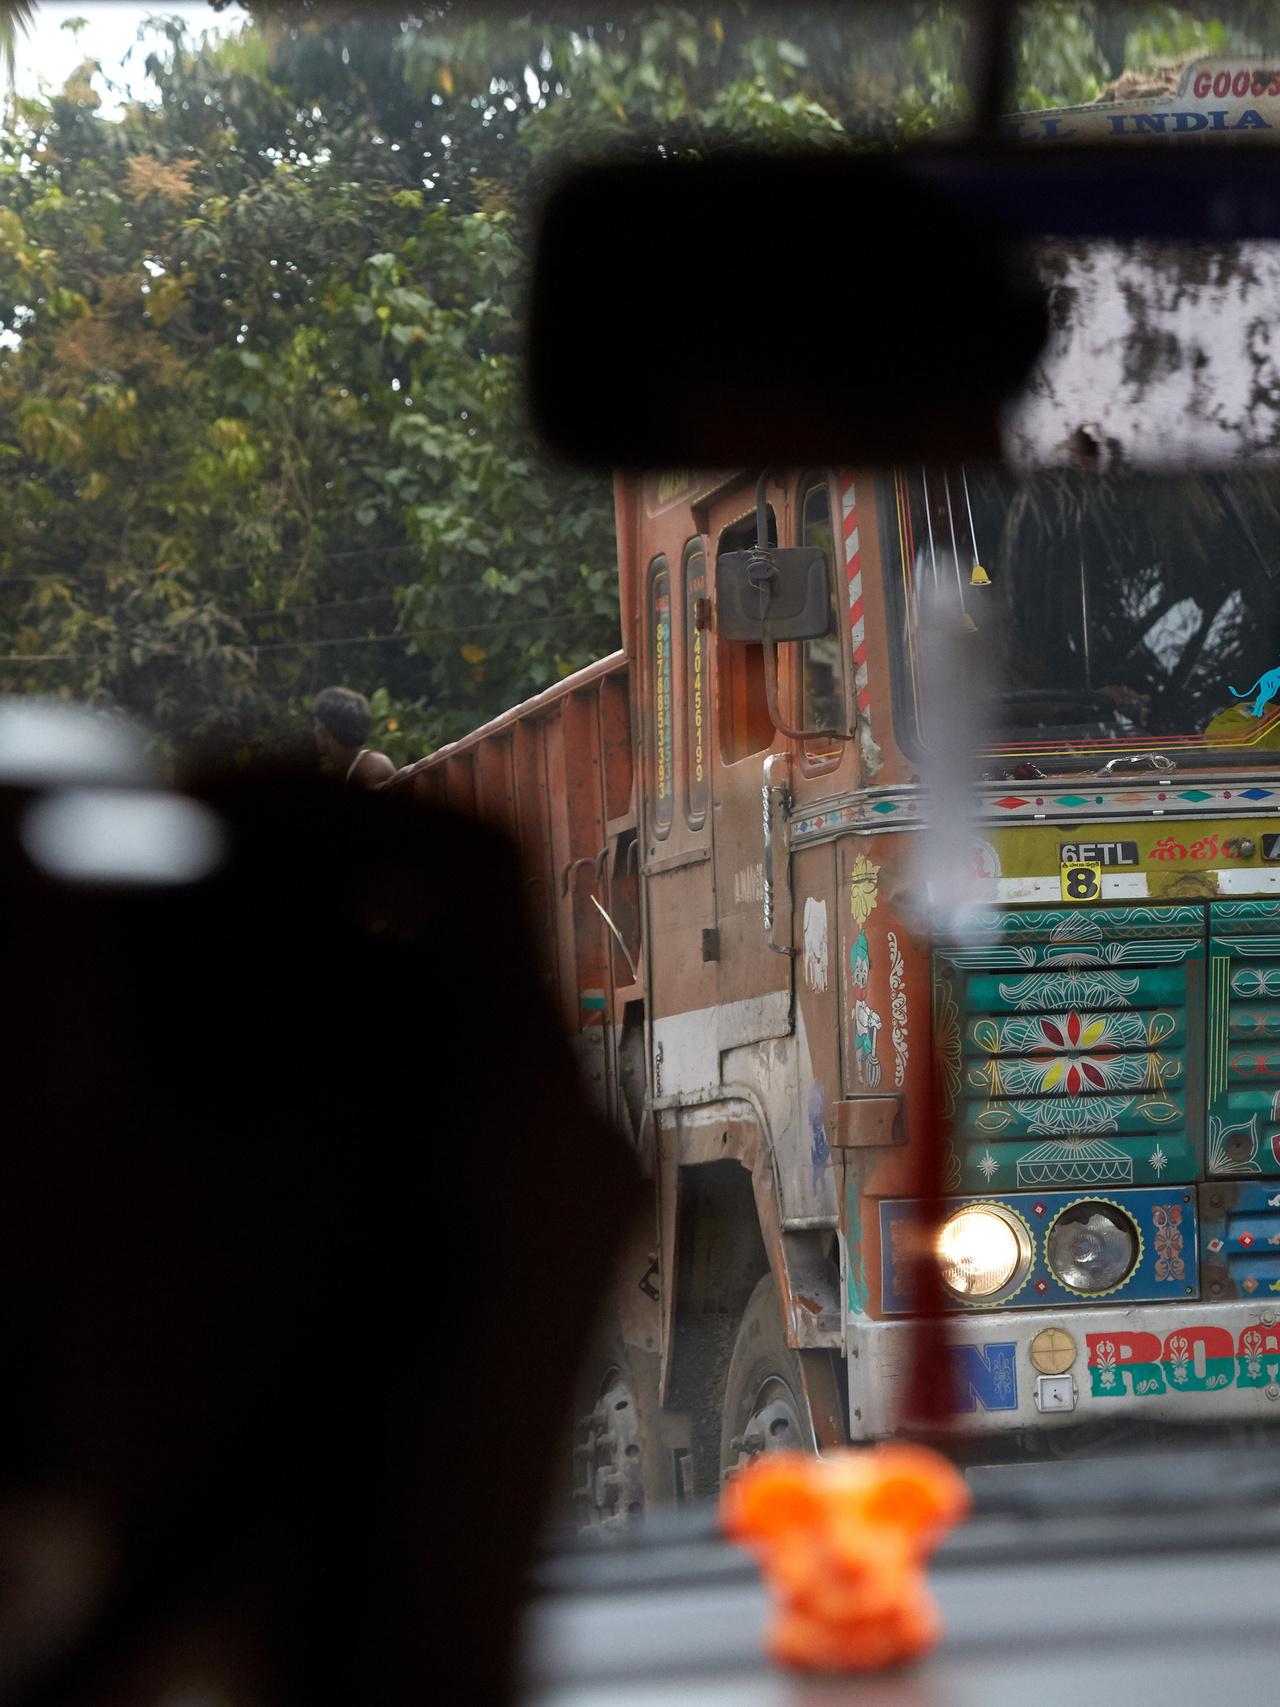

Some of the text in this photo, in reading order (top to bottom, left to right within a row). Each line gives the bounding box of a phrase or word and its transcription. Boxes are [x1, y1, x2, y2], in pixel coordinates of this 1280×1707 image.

[1000, 109, 1273, 142] LL INDIA
[1066, 867, 1099, 899] 8
